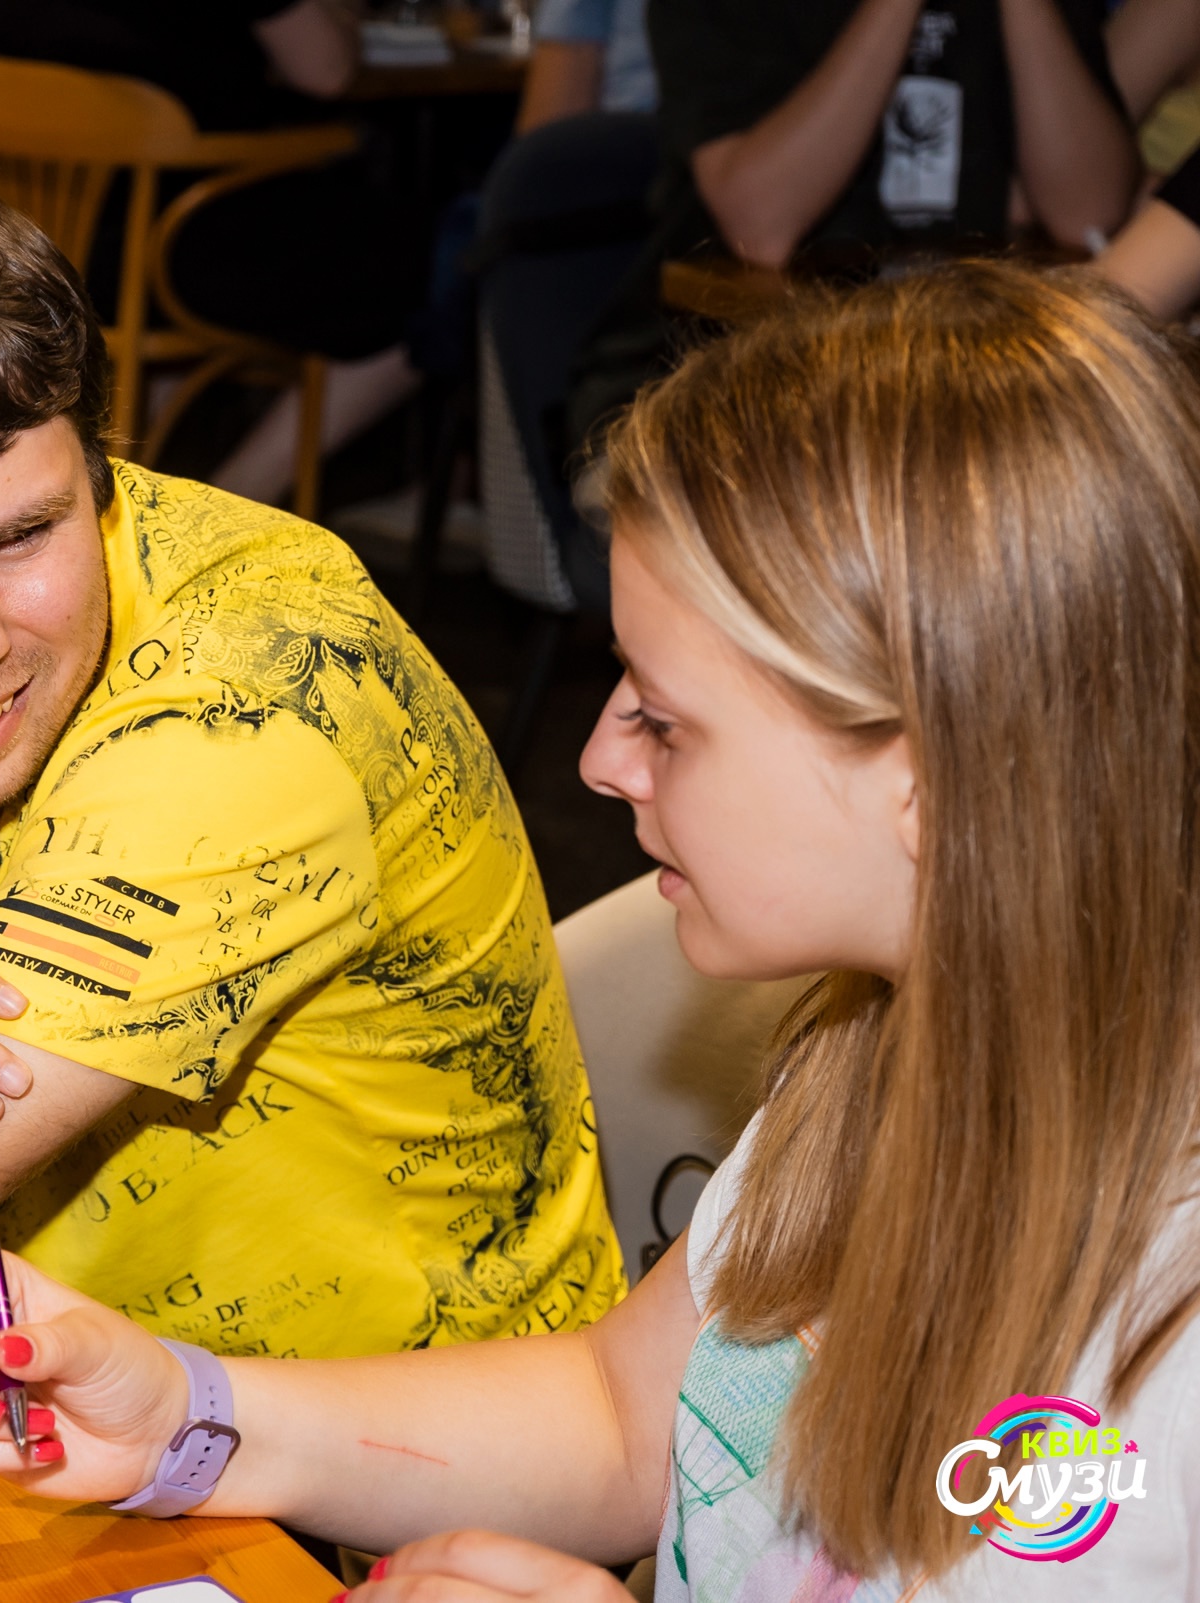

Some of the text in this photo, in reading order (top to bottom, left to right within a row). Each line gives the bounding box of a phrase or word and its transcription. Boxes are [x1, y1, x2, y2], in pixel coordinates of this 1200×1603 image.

[70, 886, 136, 925] STYLER
[120, 884, 166, 910] CLUB
[46, 965, 104, 996] JEANS
